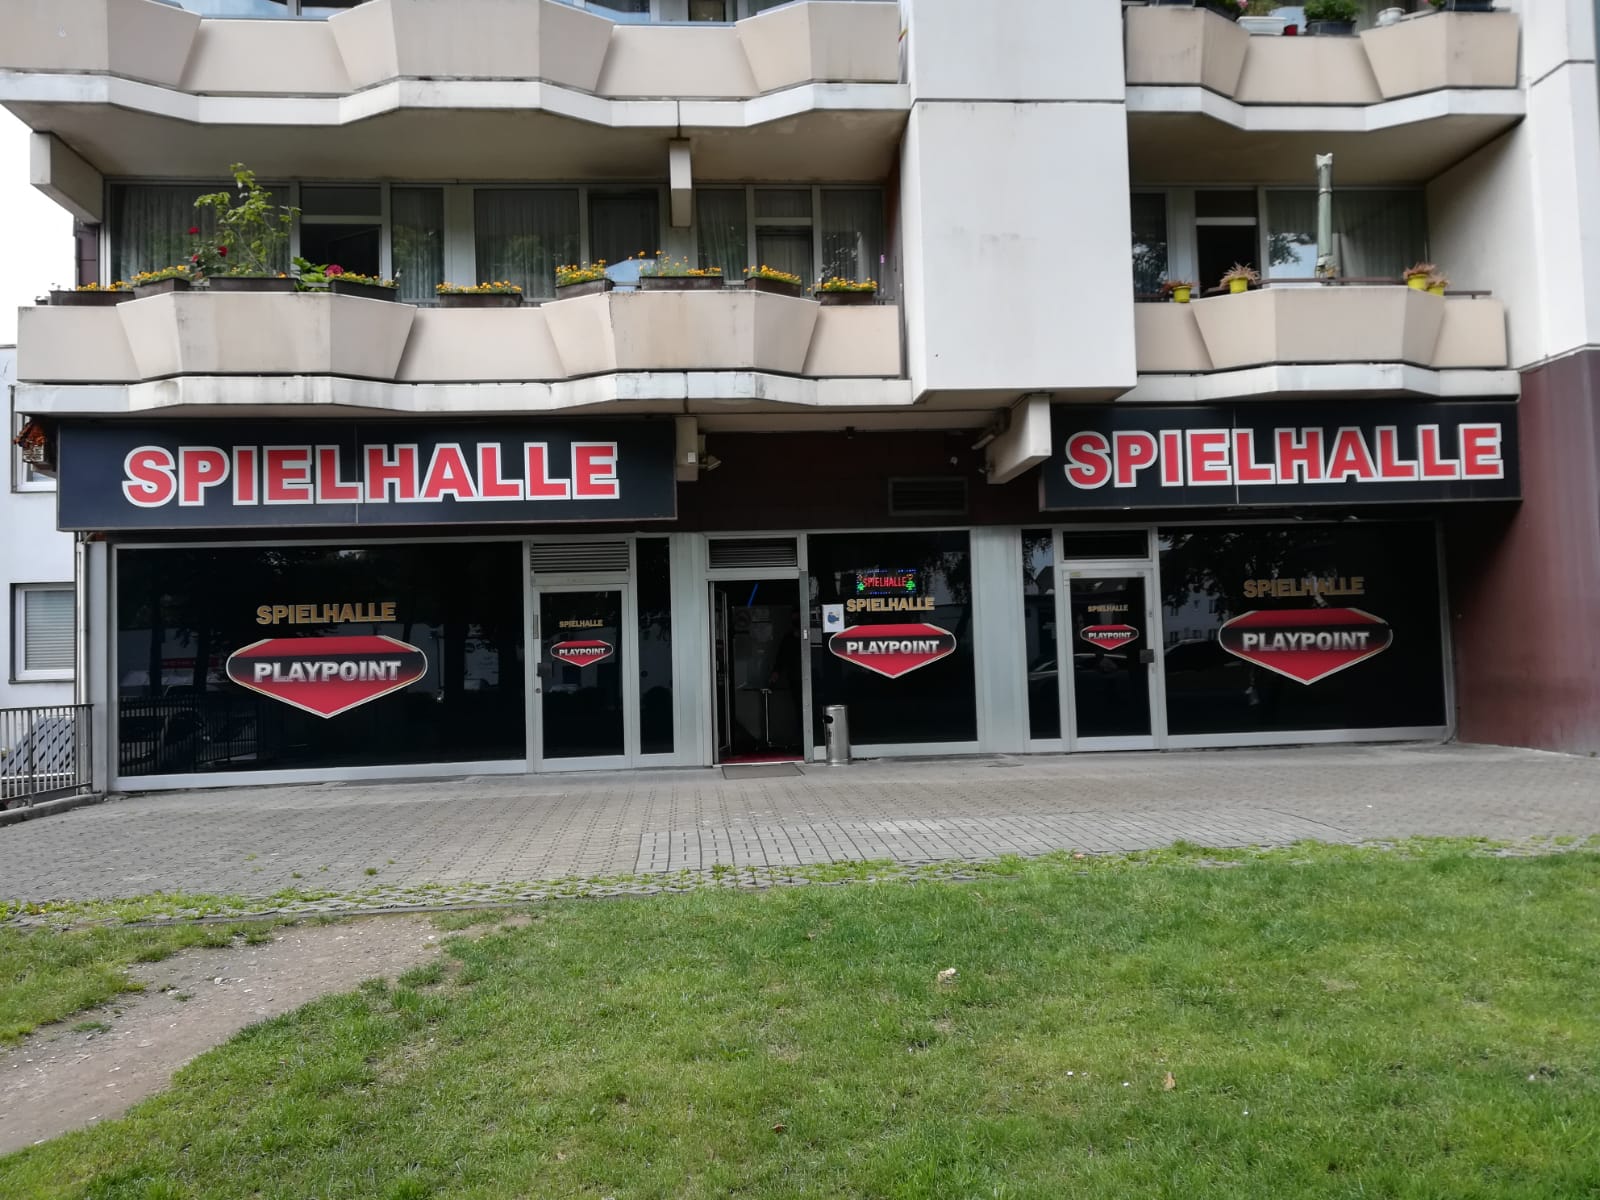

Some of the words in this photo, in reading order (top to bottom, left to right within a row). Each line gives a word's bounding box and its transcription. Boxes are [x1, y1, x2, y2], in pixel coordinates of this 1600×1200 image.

[1064, 423, 1505, 490] SPIELHALLE
[121, 441, 620, 508] SPIELHALLE
[863, 576, 907, 588] SPIELHALLE
[1243, 576, 1365, 598] SPIELHALLE
[256, 602, 397, 625] SPIELHALLE
[846, 597, 936, 613] SPIELHALLE
[1087, 604, 1128, 612] SPIELHALLE
[559, 619, 603, 627] SPIELHALLE
[846, 640, 940, 655] PLAYPOINT
[1242, 631, 1370, 652] PLAYPOINT
[559, 648, 605, 656] PLAYPOINT
[253, 660, 402, 683] PLAYPOINT
